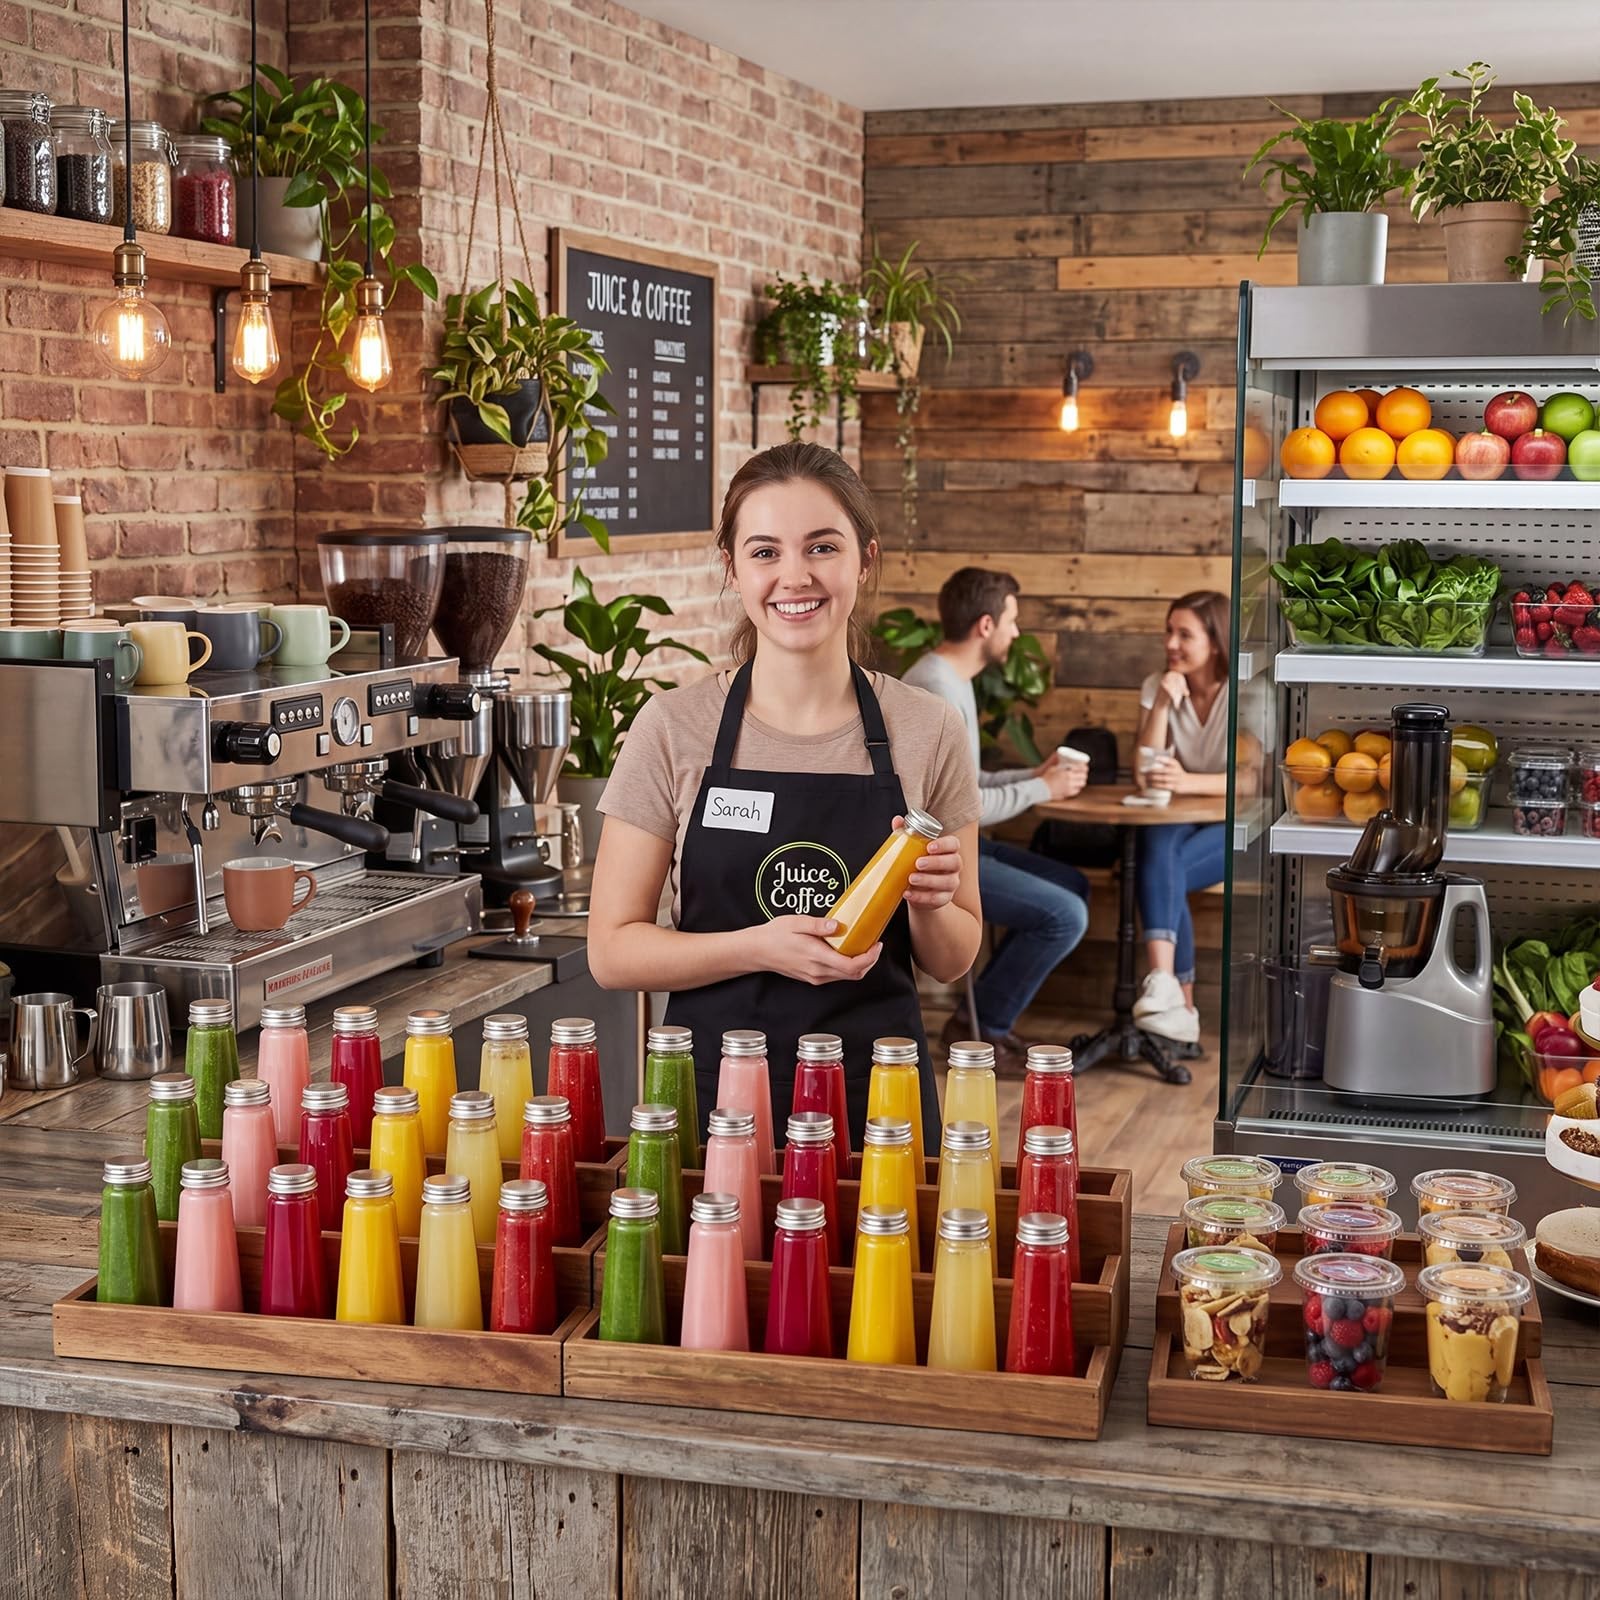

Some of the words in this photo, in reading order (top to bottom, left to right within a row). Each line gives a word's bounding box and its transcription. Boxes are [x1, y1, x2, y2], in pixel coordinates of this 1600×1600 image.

[587, 271, 628, 315] JUICE
[631, 279, 642, 318] &
[645, 282, 692, 326] COFFEE
[711, 796, 761, 821] Sarah
[773, 861, 830, 889] Juice
[770, 887, 836, 915] Coffee
